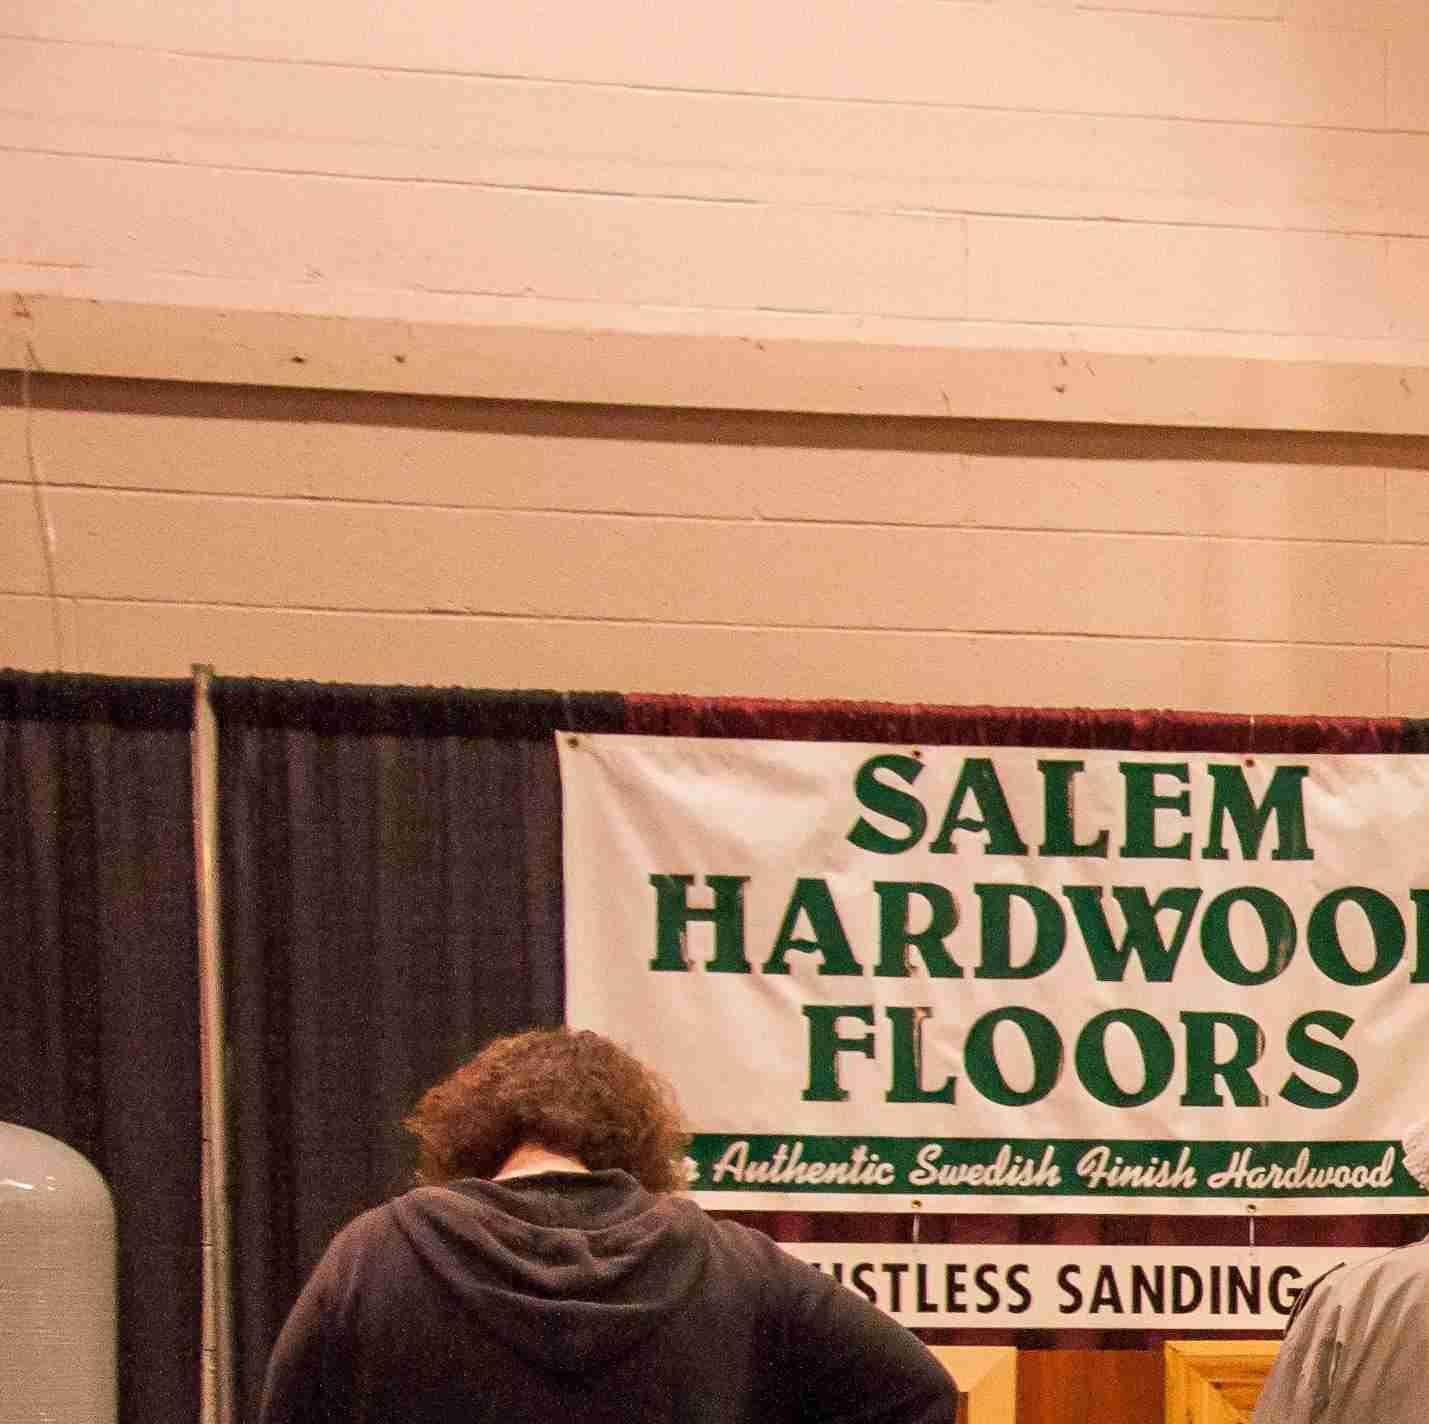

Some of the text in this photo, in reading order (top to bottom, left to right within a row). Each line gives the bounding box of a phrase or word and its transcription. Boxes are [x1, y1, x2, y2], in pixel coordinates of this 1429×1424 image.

[849, 754, 1314, 862] SALEM
[801, 1004, 1359, 1108] FLOORS
[713, 1141, 895, 1187] Authentic
[908, 1144, 1061, 1189] Swedish
[1078, 1146, 1197, 1189] Finish
[1207, 1147, 1394, 1190] Hardwood
[1056, 1263, 1304, 1315] SANDING
